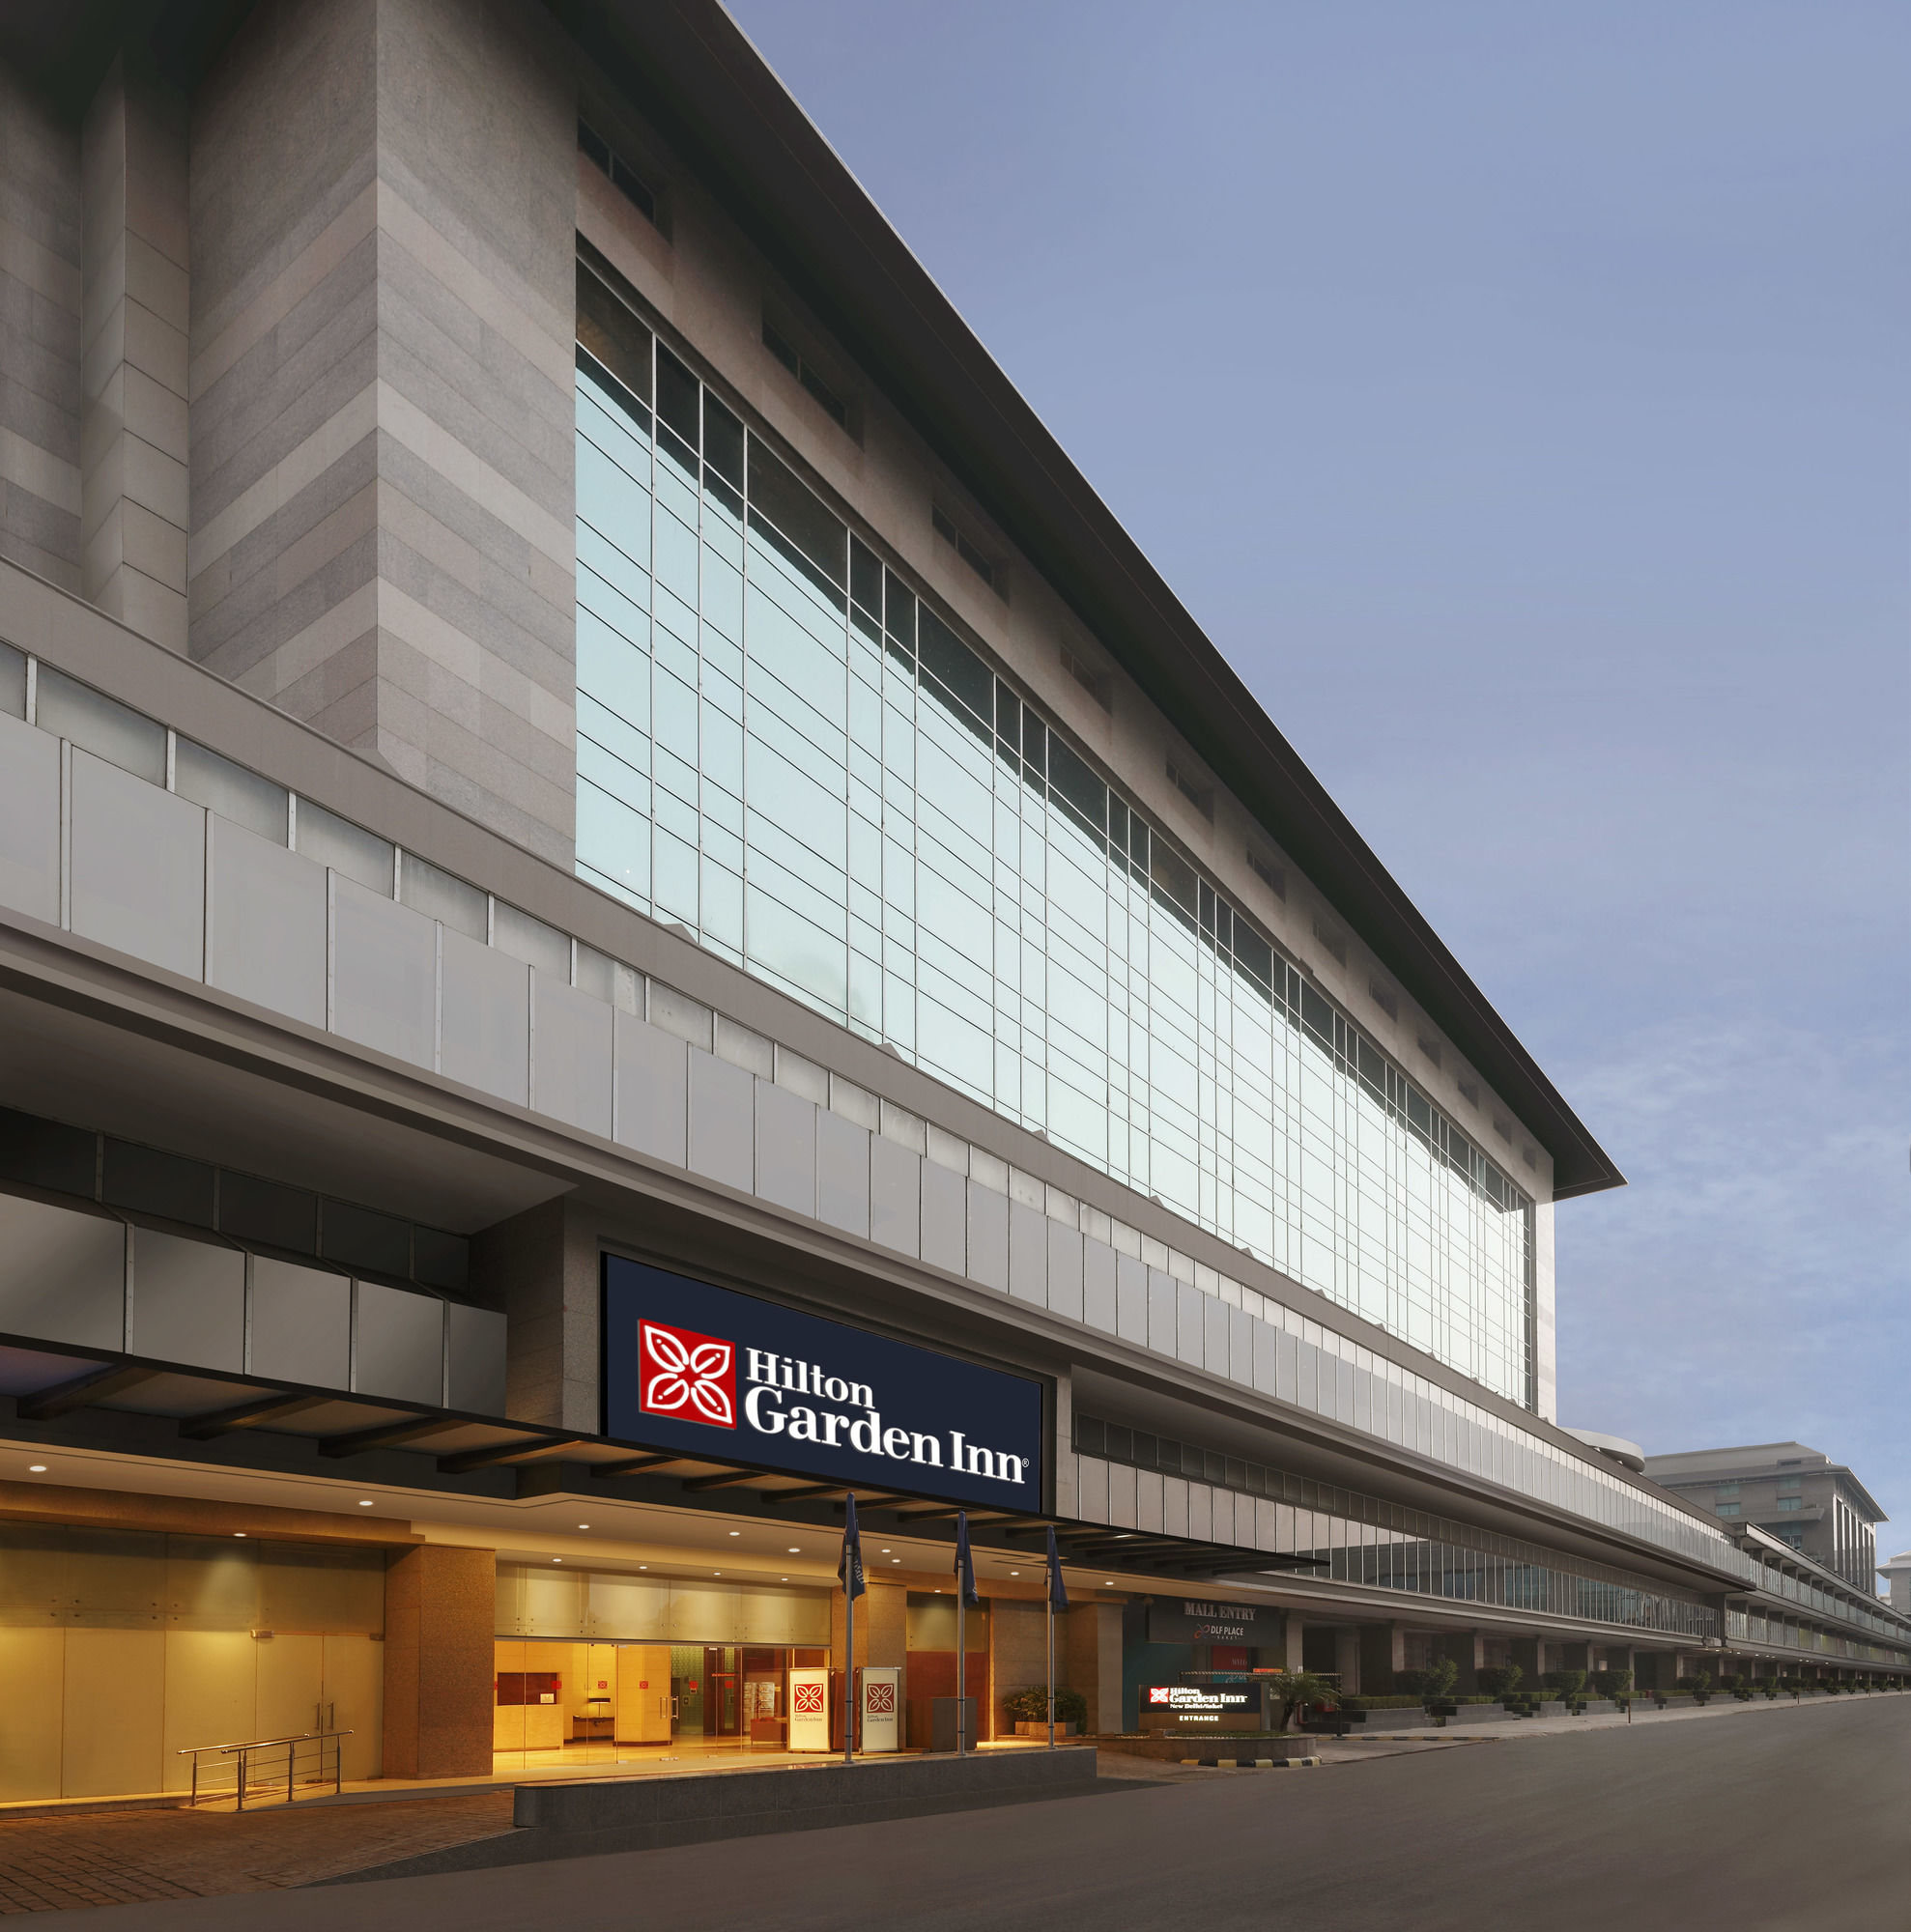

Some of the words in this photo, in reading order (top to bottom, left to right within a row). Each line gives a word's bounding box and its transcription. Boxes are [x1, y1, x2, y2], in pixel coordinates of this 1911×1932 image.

[745, 1347, 875, 1409] Hilton
[744, 1385, 944, 1468] Garden
[1184, 1601, 1217, 1618] MALL
[1218, 1605, 1256, 1621] ENTRY
[1211, 1625, 1223, 1634] DLF
[1223, 1626, 1244, 1635] PLACE
[1169, 1693, 1218, 1703] Garden
